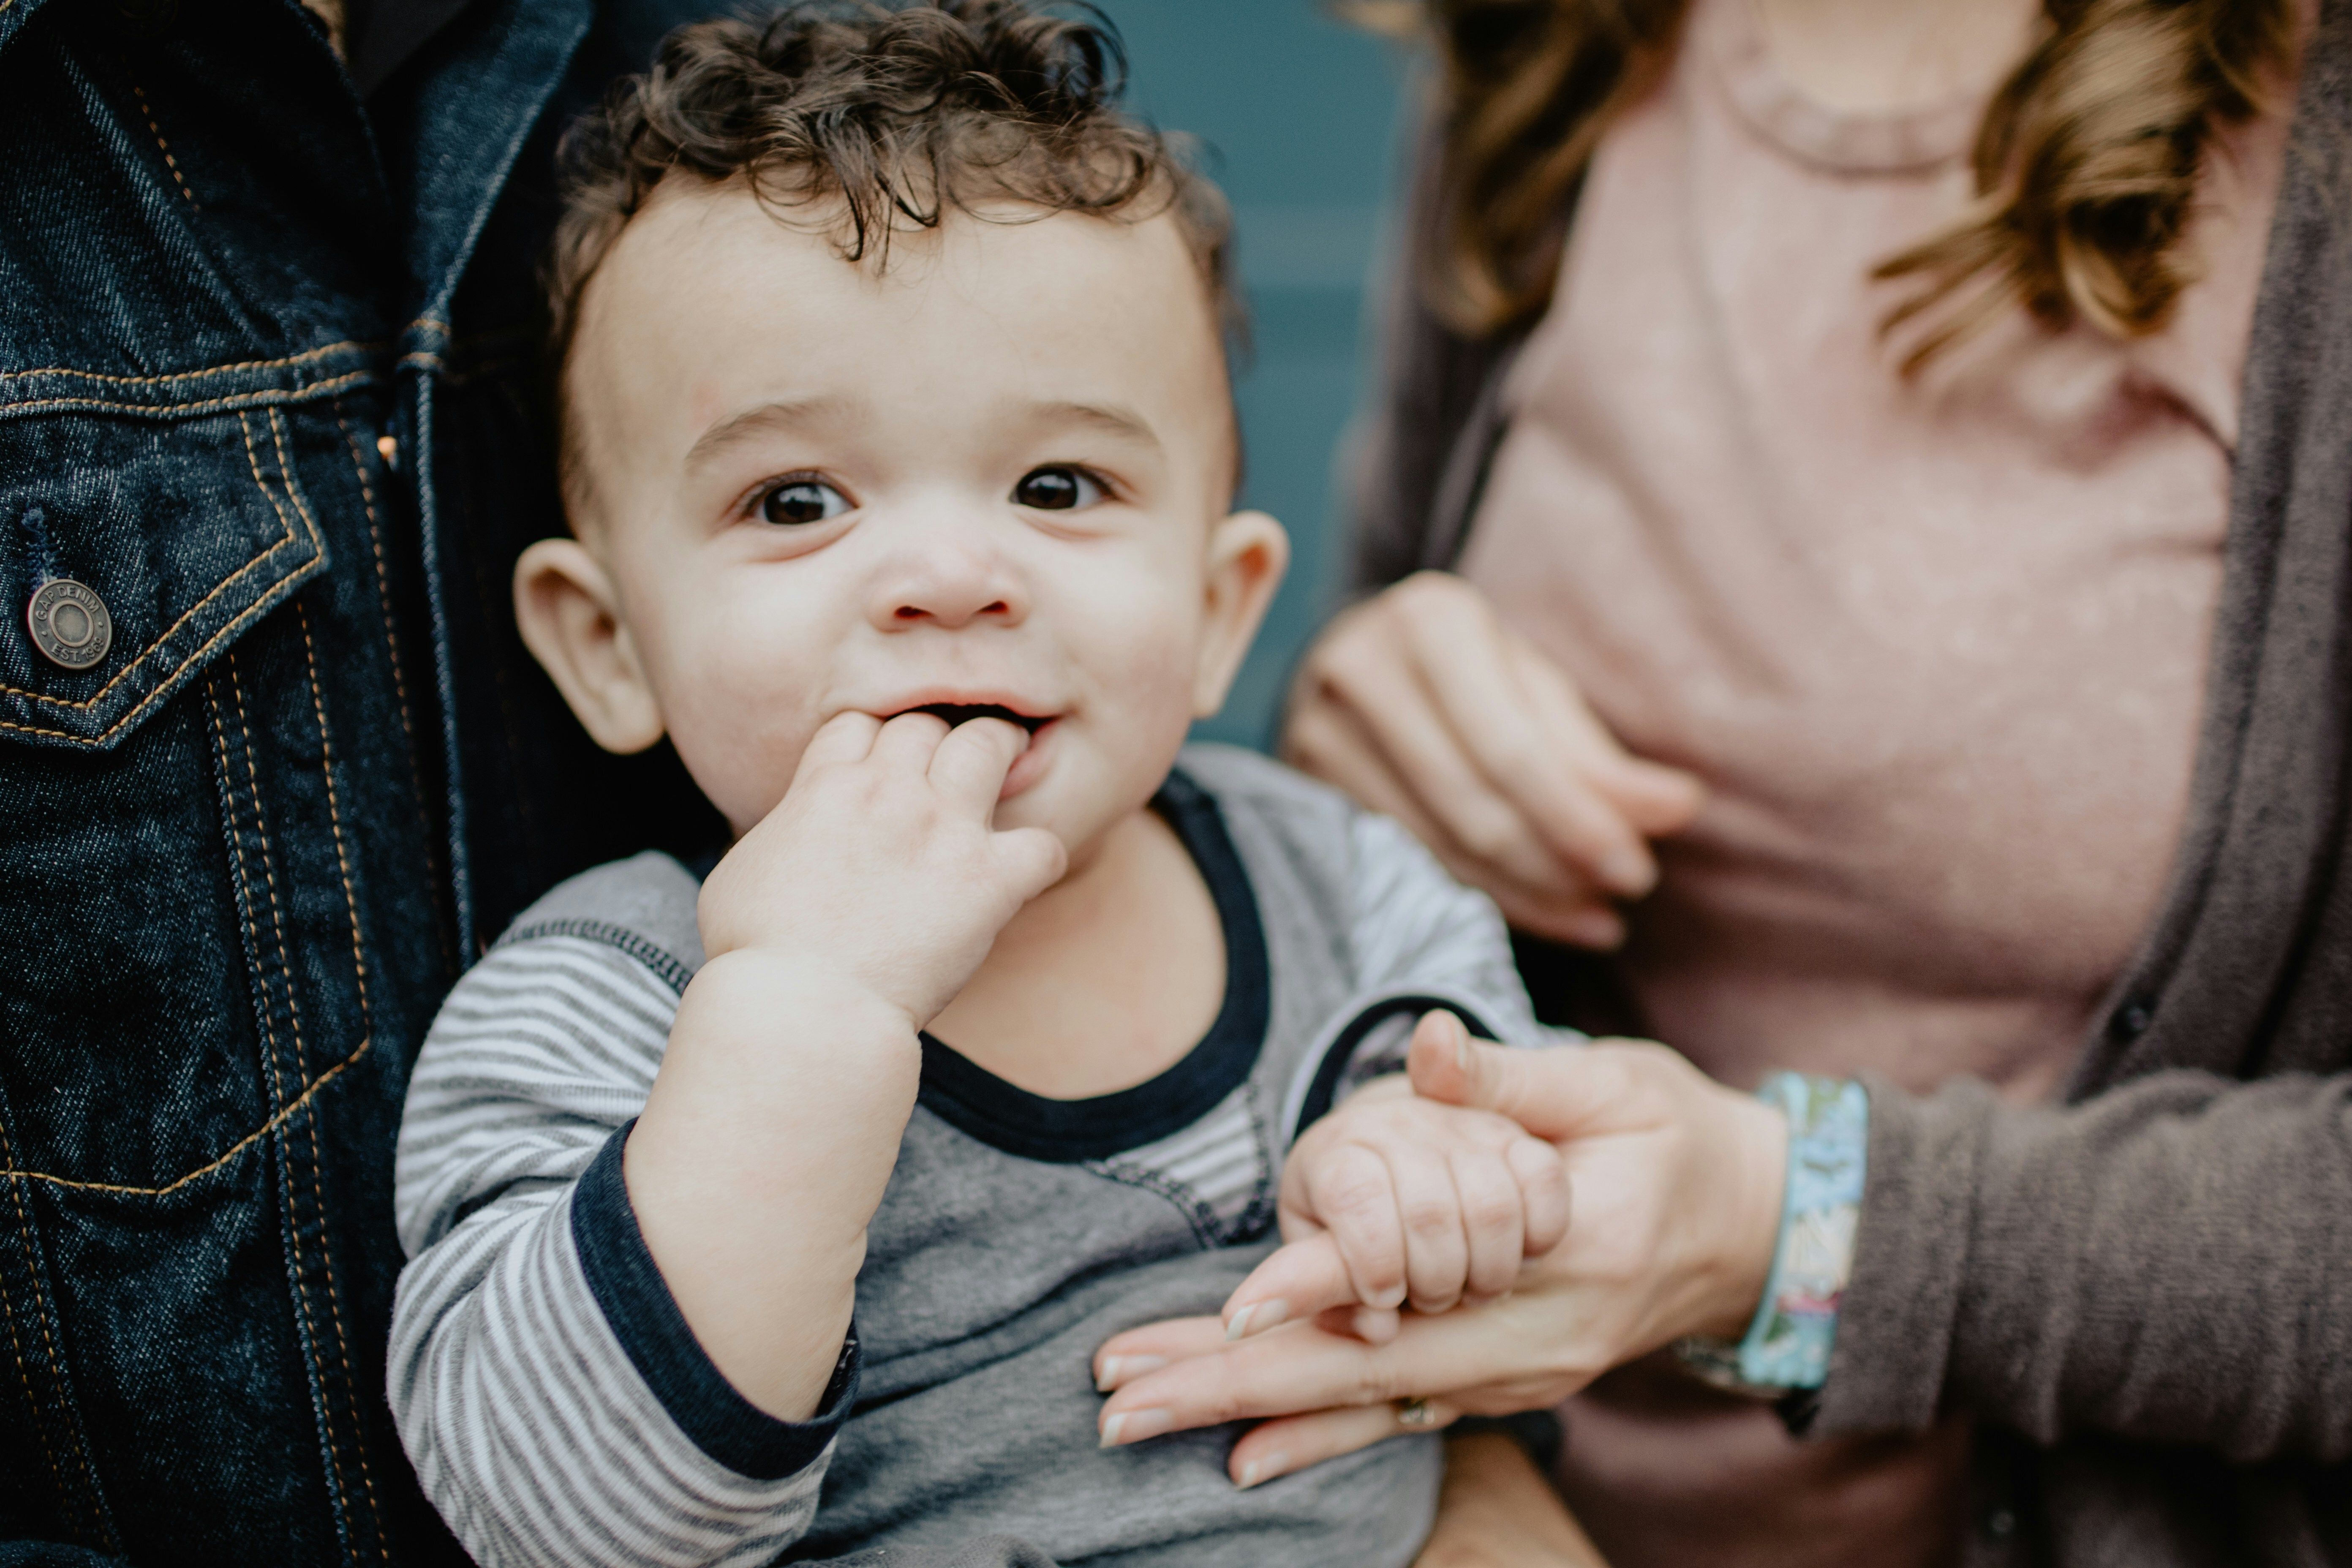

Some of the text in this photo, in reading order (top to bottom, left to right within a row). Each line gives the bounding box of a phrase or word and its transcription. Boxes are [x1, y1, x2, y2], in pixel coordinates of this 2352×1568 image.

[35, 586, 100, 620] GAP DENIM
[51, 637, 104, 662] EST. 1969
